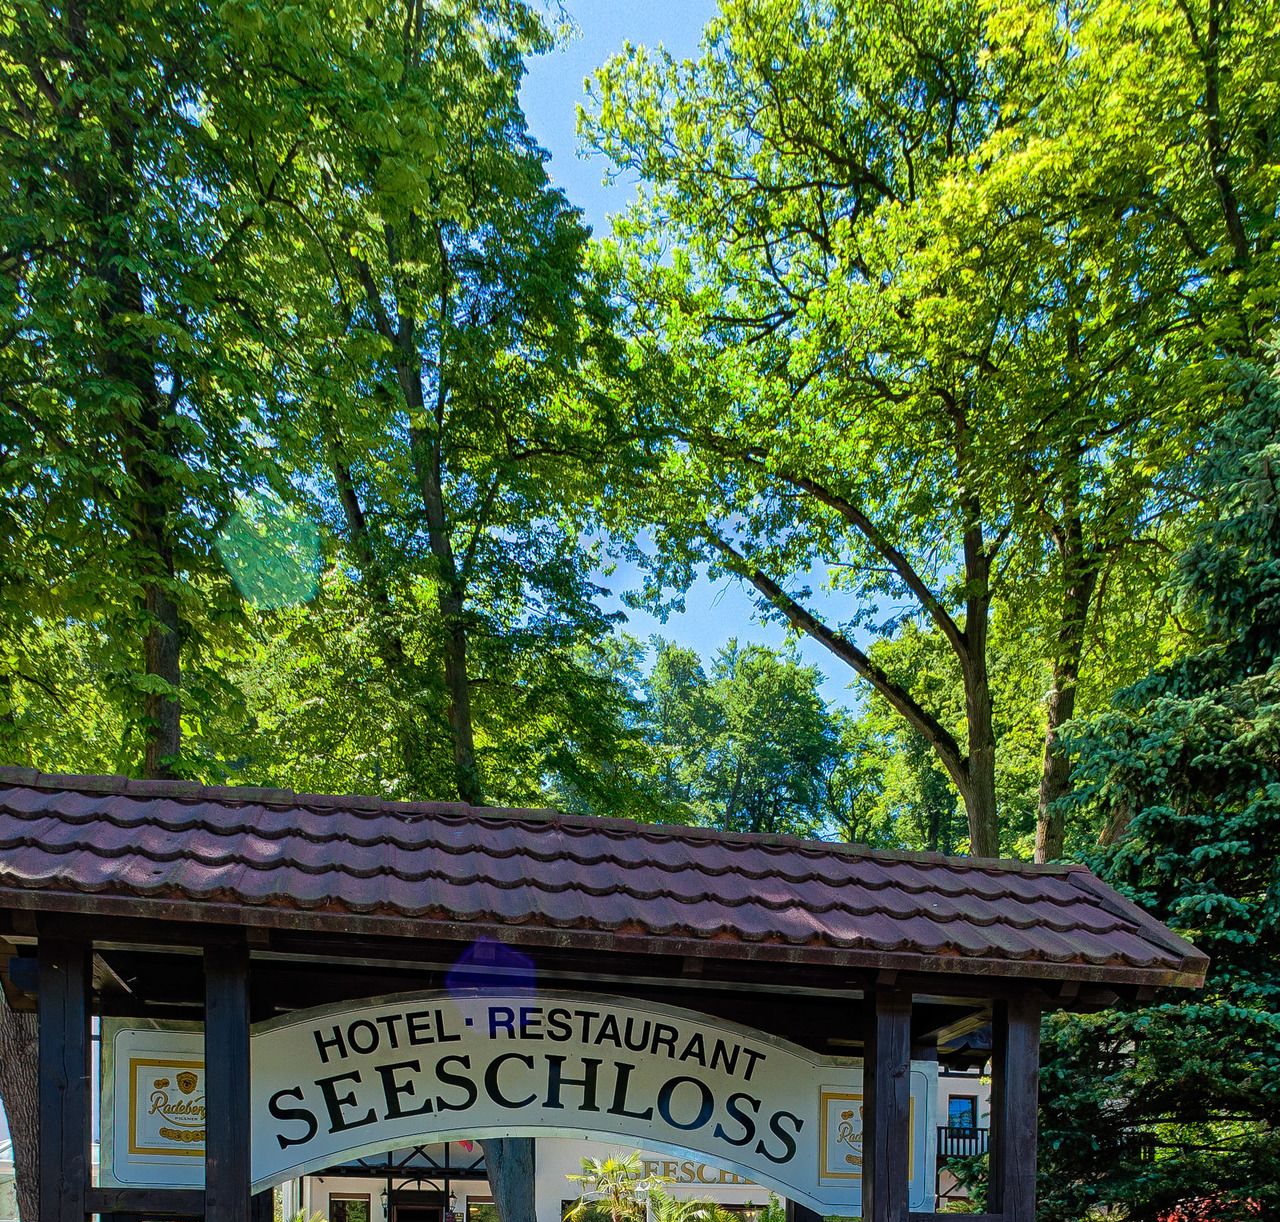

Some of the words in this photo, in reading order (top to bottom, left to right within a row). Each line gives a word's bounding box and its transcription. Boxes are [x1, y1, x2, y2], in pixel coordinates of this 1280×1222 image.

[313, 1009, 461, 1063] HOTEL
[488, 1006, 767, 1082] RESTAURANT
[267, 1052, 804, 1164] SEESCHLOSS
